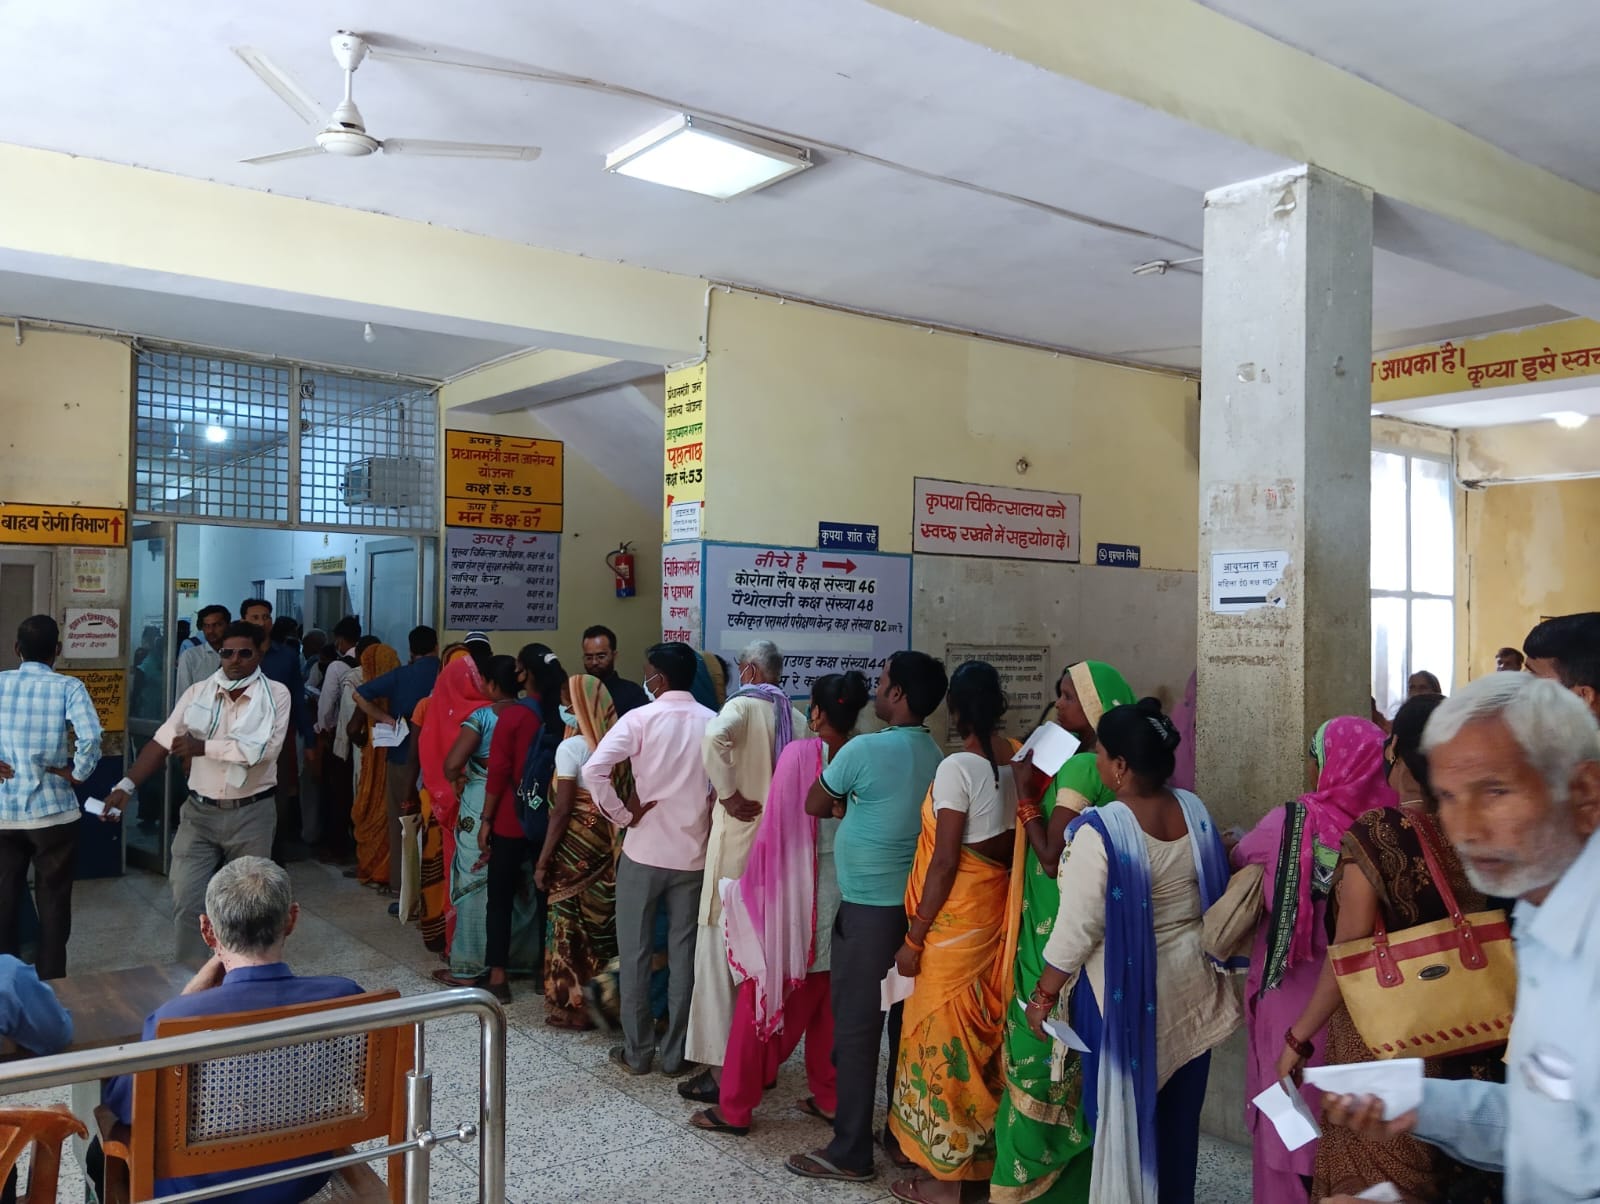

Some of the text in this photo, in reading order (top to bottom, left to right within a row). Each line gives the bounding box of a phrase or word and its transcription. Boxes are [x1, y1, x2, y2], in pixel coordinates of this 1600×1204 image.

[1379, 351, 1440, 382] आपका
[1521, 346, 1558, 382] इसे
[478, 463, 515, 479] योजना
[465, 482, 491, 496] कक्ष
[925, 491, 1067, 520] कृपया चिकित्सालय को
[41, 510, 70, 532] रोगी
[71, 513, 110, 533] विभाग
[472, 533, 506, 546] ऊपर
[820, 529, 844, 545] कृपया
[846, 528, 863, 543] शांत
[959, 523, 994, 543] रखने
[994, 523, 1006, 544] में
[1006, 527, 1054, 549] सहयोग
[755, 551, 808, 574] नीचे है
[1223, 561, 1260, 574] आयुष्मान
[735, 569, 775, 587] कोरोना
[798, 576, 822, 592] कक्ष
[823, 574, 856, 593] संख्या
[858, 579, 875, 594] 46
[731, 590, 874, 613] पैथोलाजी कक्ष संख्या 48
[670, 606, 689, 619] करना
[727, 611, 764, 631] एकीकृत
[763, 613, 790, 630] परामर्श
[790, 612, 817, 630] परीक्षण
[834, 617, 850, 631] कक्ष
[851, 616, 873, 632] संख्या
[873, 620, 887, 632] 82
[815, 655, 838, 669] कक्ष
[840, 654, 869, 670] संख्या
